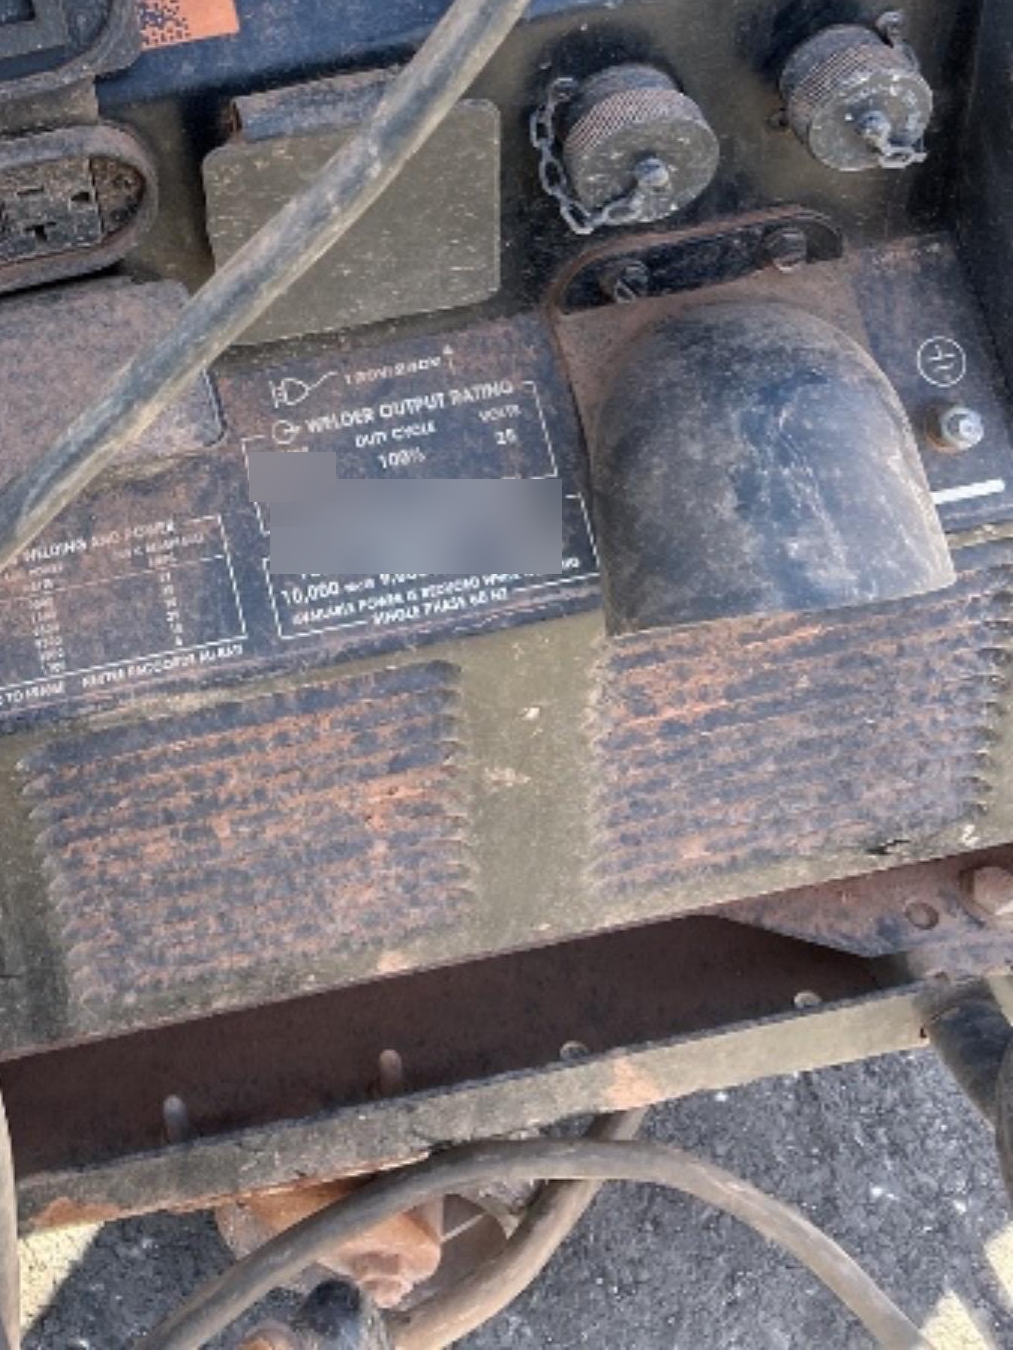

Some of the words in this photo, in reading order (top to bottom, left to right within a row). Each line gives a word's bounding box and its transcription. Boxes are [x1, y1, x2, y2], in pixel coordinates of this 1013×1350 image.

[305, 407, 374, 434] WELDER
[379, 393, 445, 419] OUTPUT
[451, 380, 514, 404] RATING
